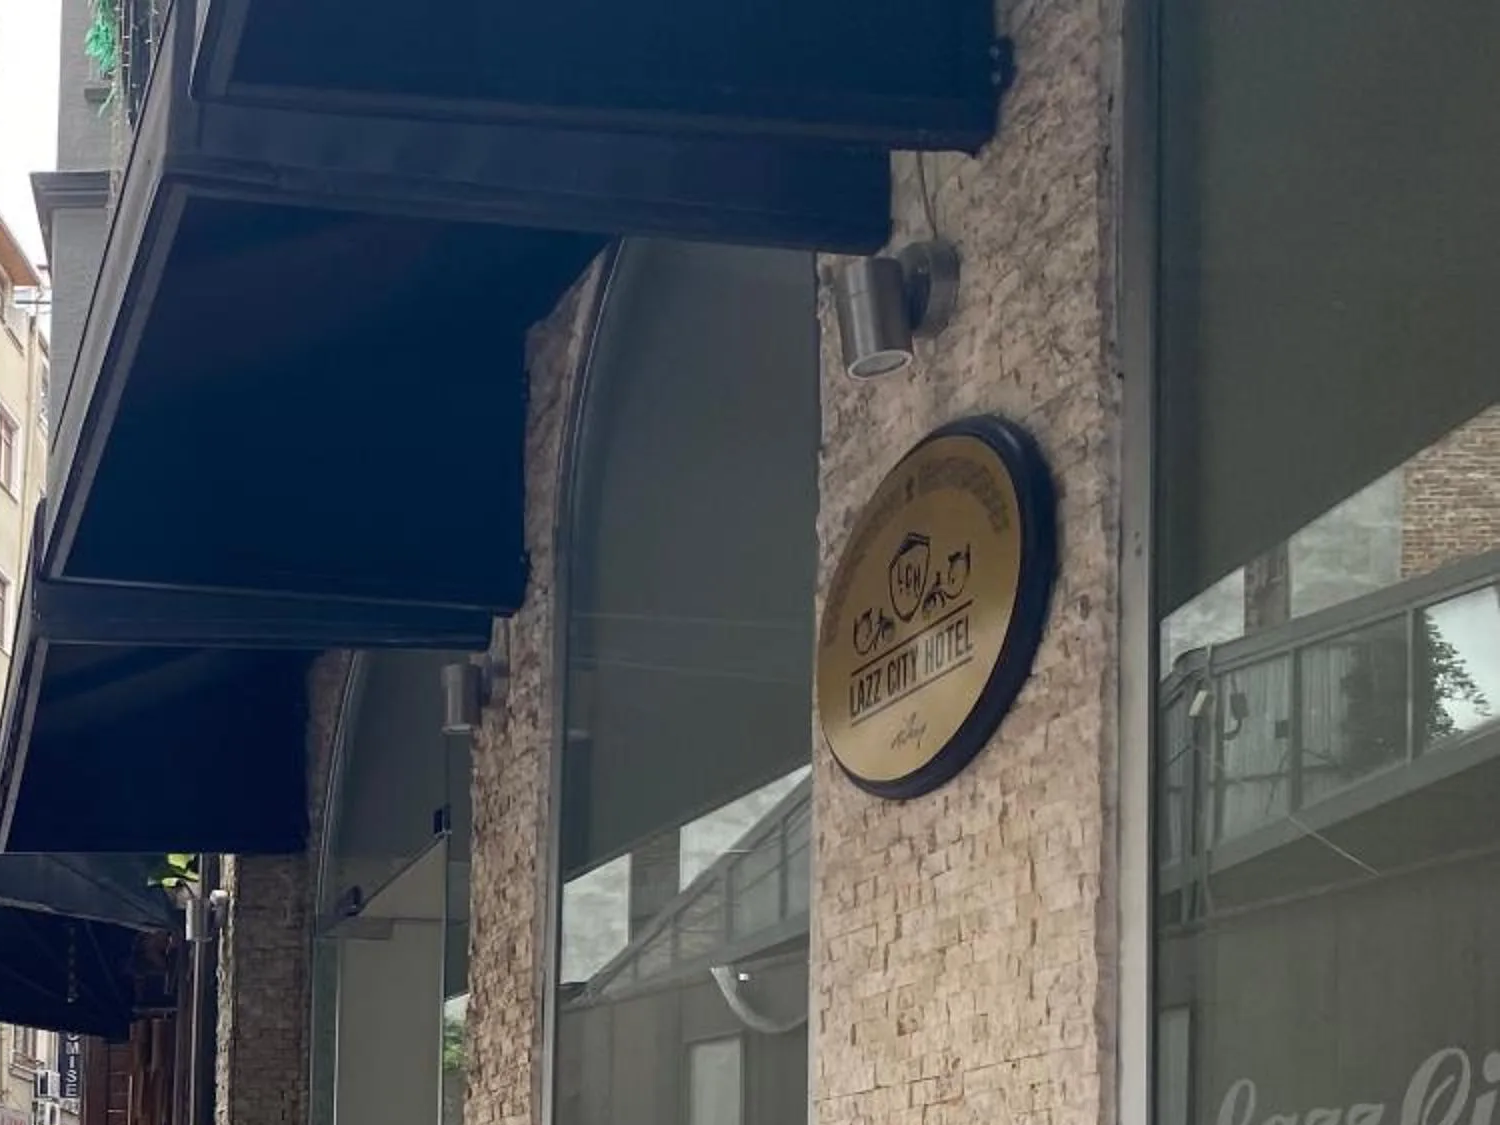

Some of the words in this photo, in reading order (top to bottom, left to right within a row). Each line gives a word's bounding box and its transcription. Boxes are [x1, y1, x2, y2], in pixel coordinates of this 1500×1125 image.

[850, 667, 882, 717] LAZZ
[887, 645, 919, 696] CITY
[925, 614, 973, 675] HOTEL
